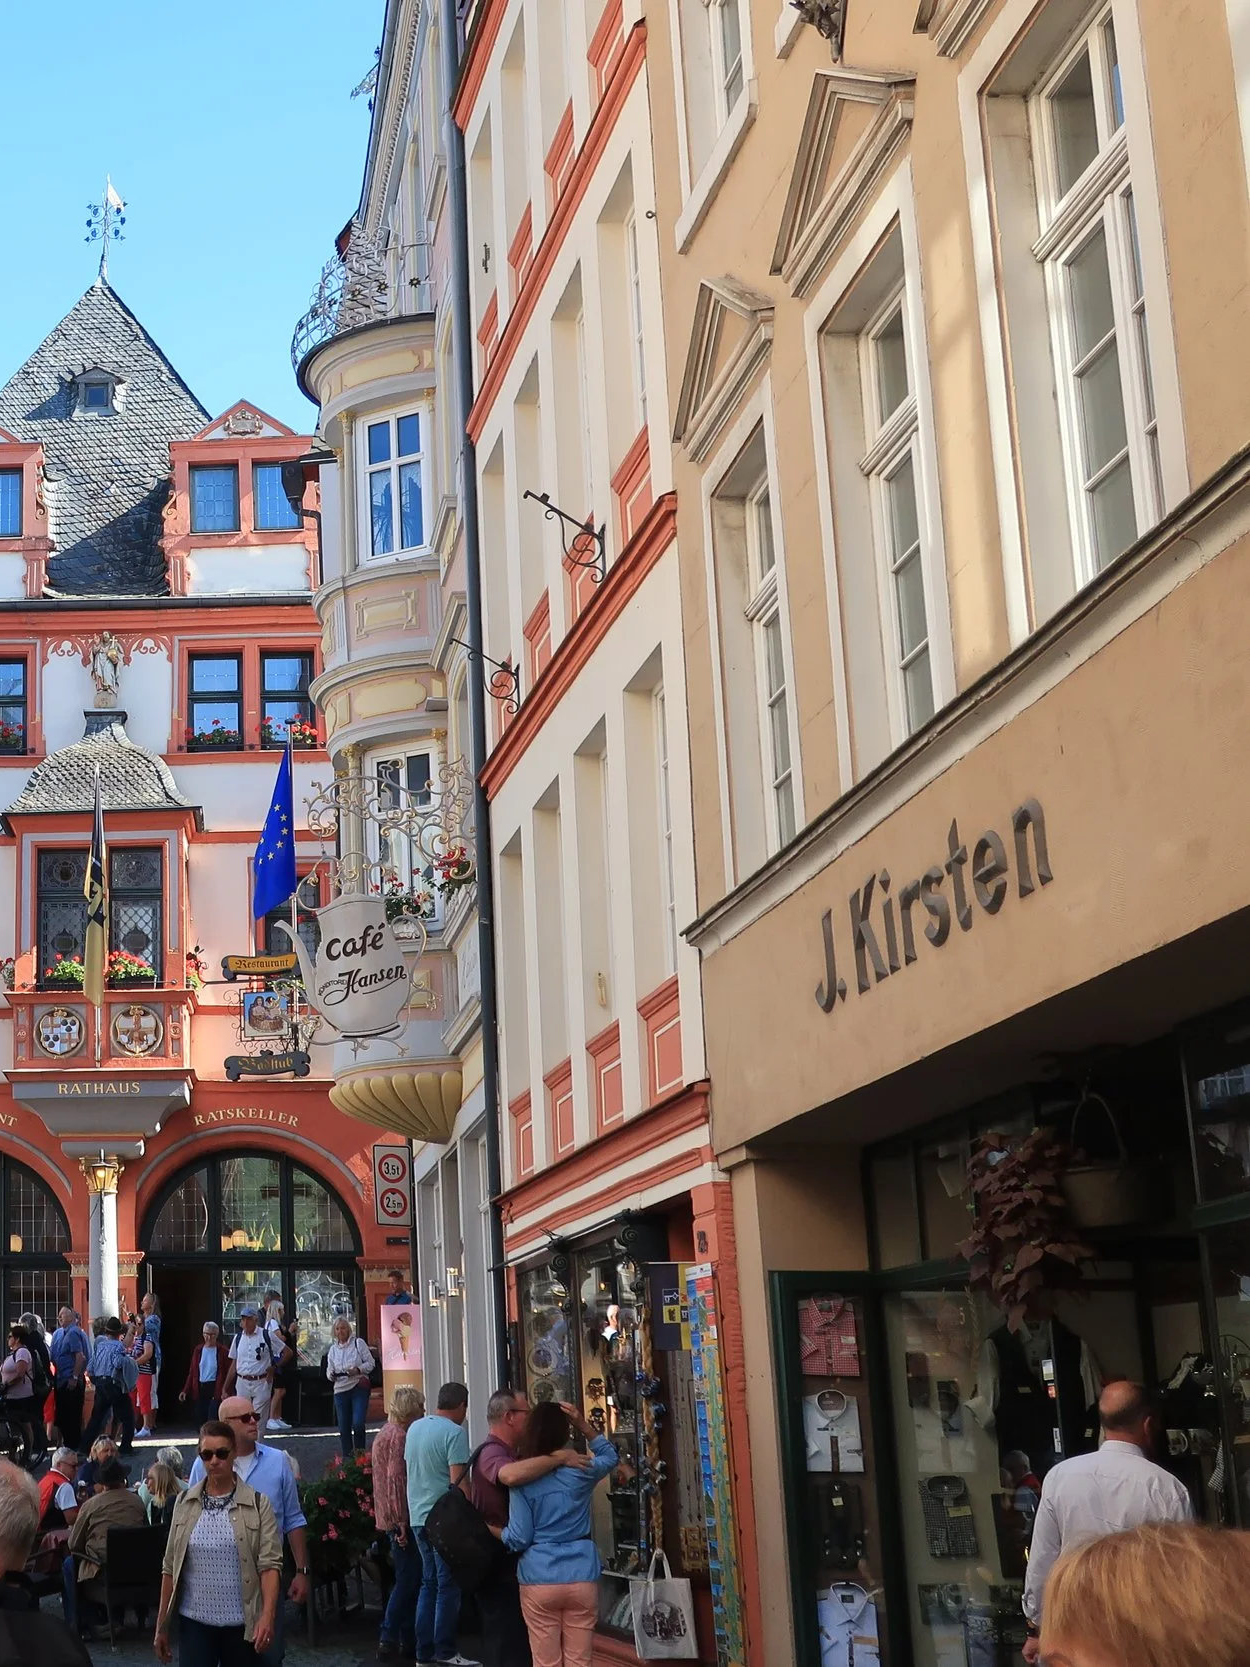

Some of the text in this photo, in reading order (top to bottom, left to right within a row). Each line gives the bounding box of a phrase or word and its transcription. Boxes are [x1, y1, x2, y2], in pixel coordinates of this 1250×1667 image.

[234, 957, 290, 970] Restaurant
[323, 964, 408, 1007] Hansen
[57, 1081, 141, 1095] RATHAUS
[193, 1107, 299, 1128] RATSKELLER
